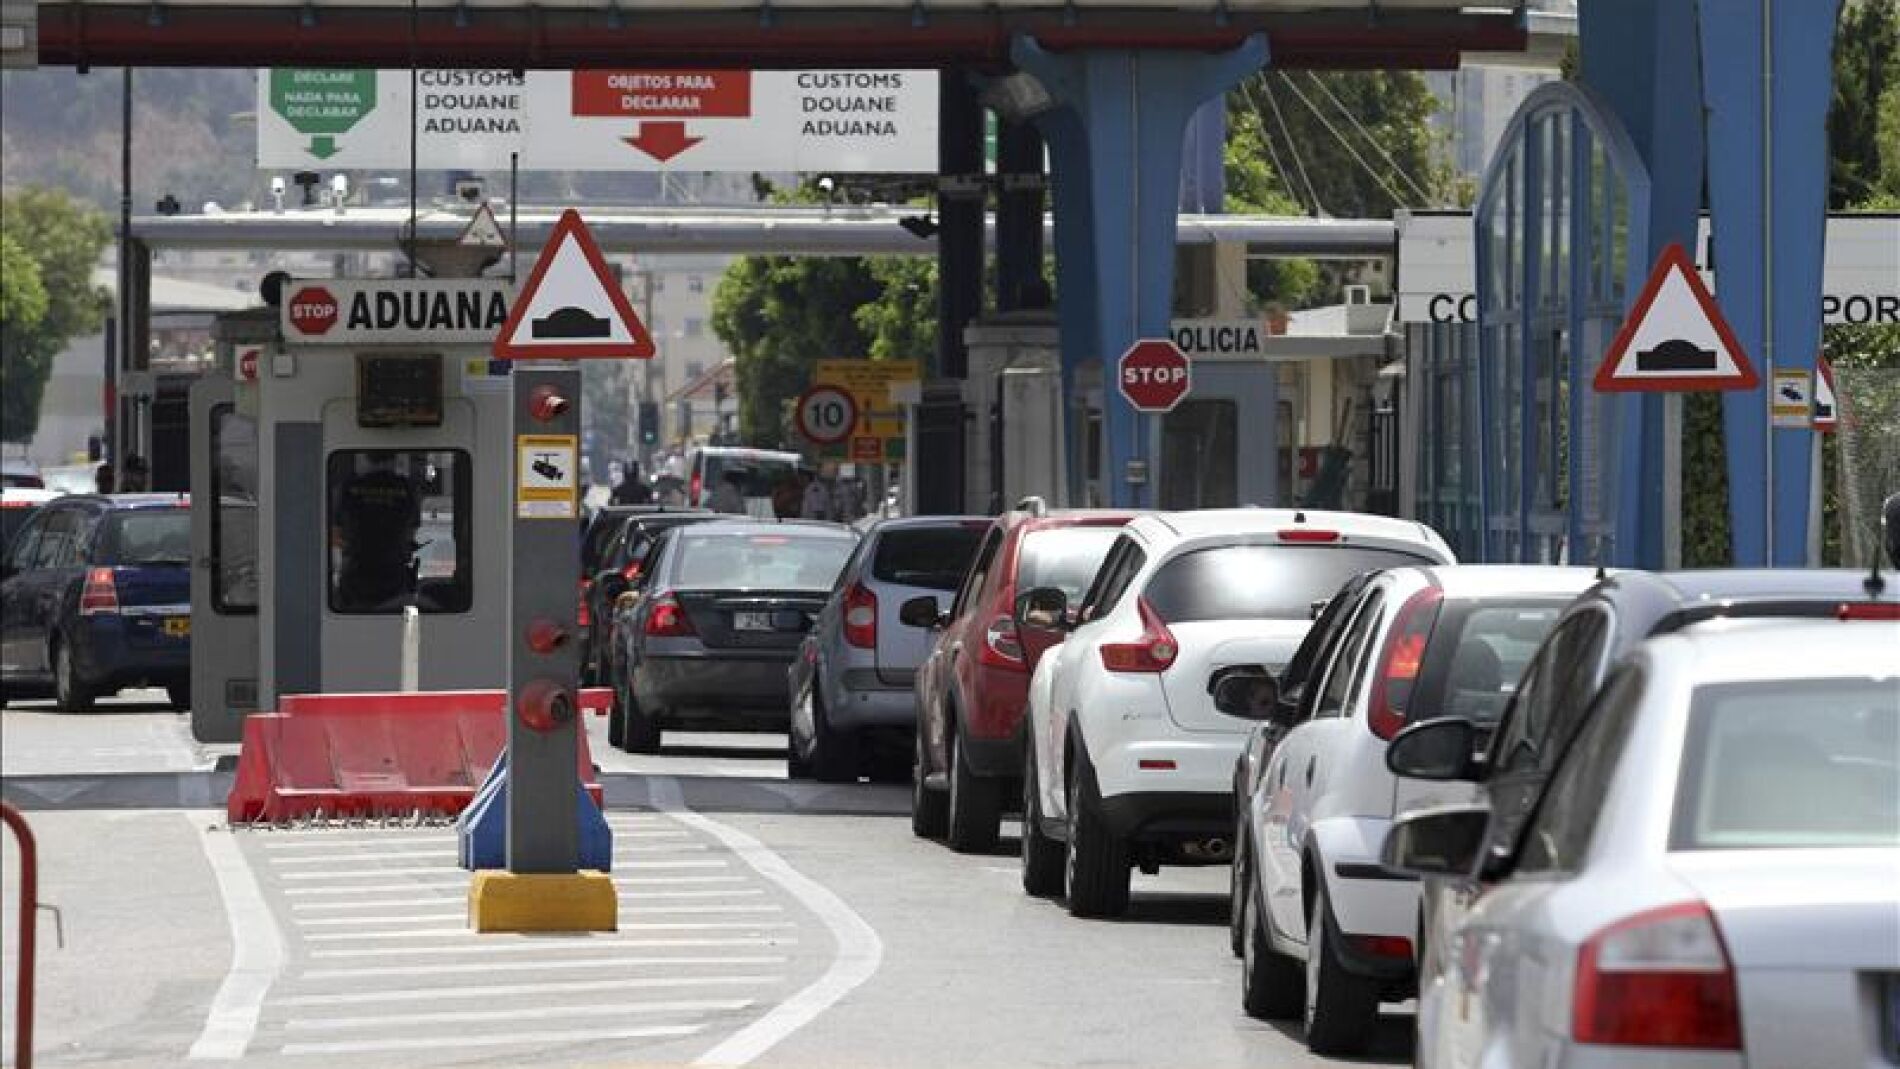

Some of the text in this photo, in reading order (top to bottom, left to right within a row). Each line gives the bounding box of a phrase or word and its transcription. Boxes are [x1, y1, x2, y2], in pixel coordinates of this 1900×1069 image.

[608, 75, 715, 92] OBJETOS PARA
[798, 73, 903, 89] CUSTOMS
[284, 92, 361, 104] NADA PARA
[425, 94, 519, 110] DOUANE
[622, 95, 701, 109] DECLARAR
[803, 96, 896, 113] DOUANE
[286, 106, 358, 117] DECLARAR
[425, 118, 520, 133] ADUANA
[802, 120, 897, 136] ADUANA
[292, 304, 334, 319] STOP
[347, 291, 507, 329] ADUANA
[1171, 327, 1258, 352] OLICIA
[1125, 368, 1184, 383] STOP
[811, 403, 843, 427] 10
